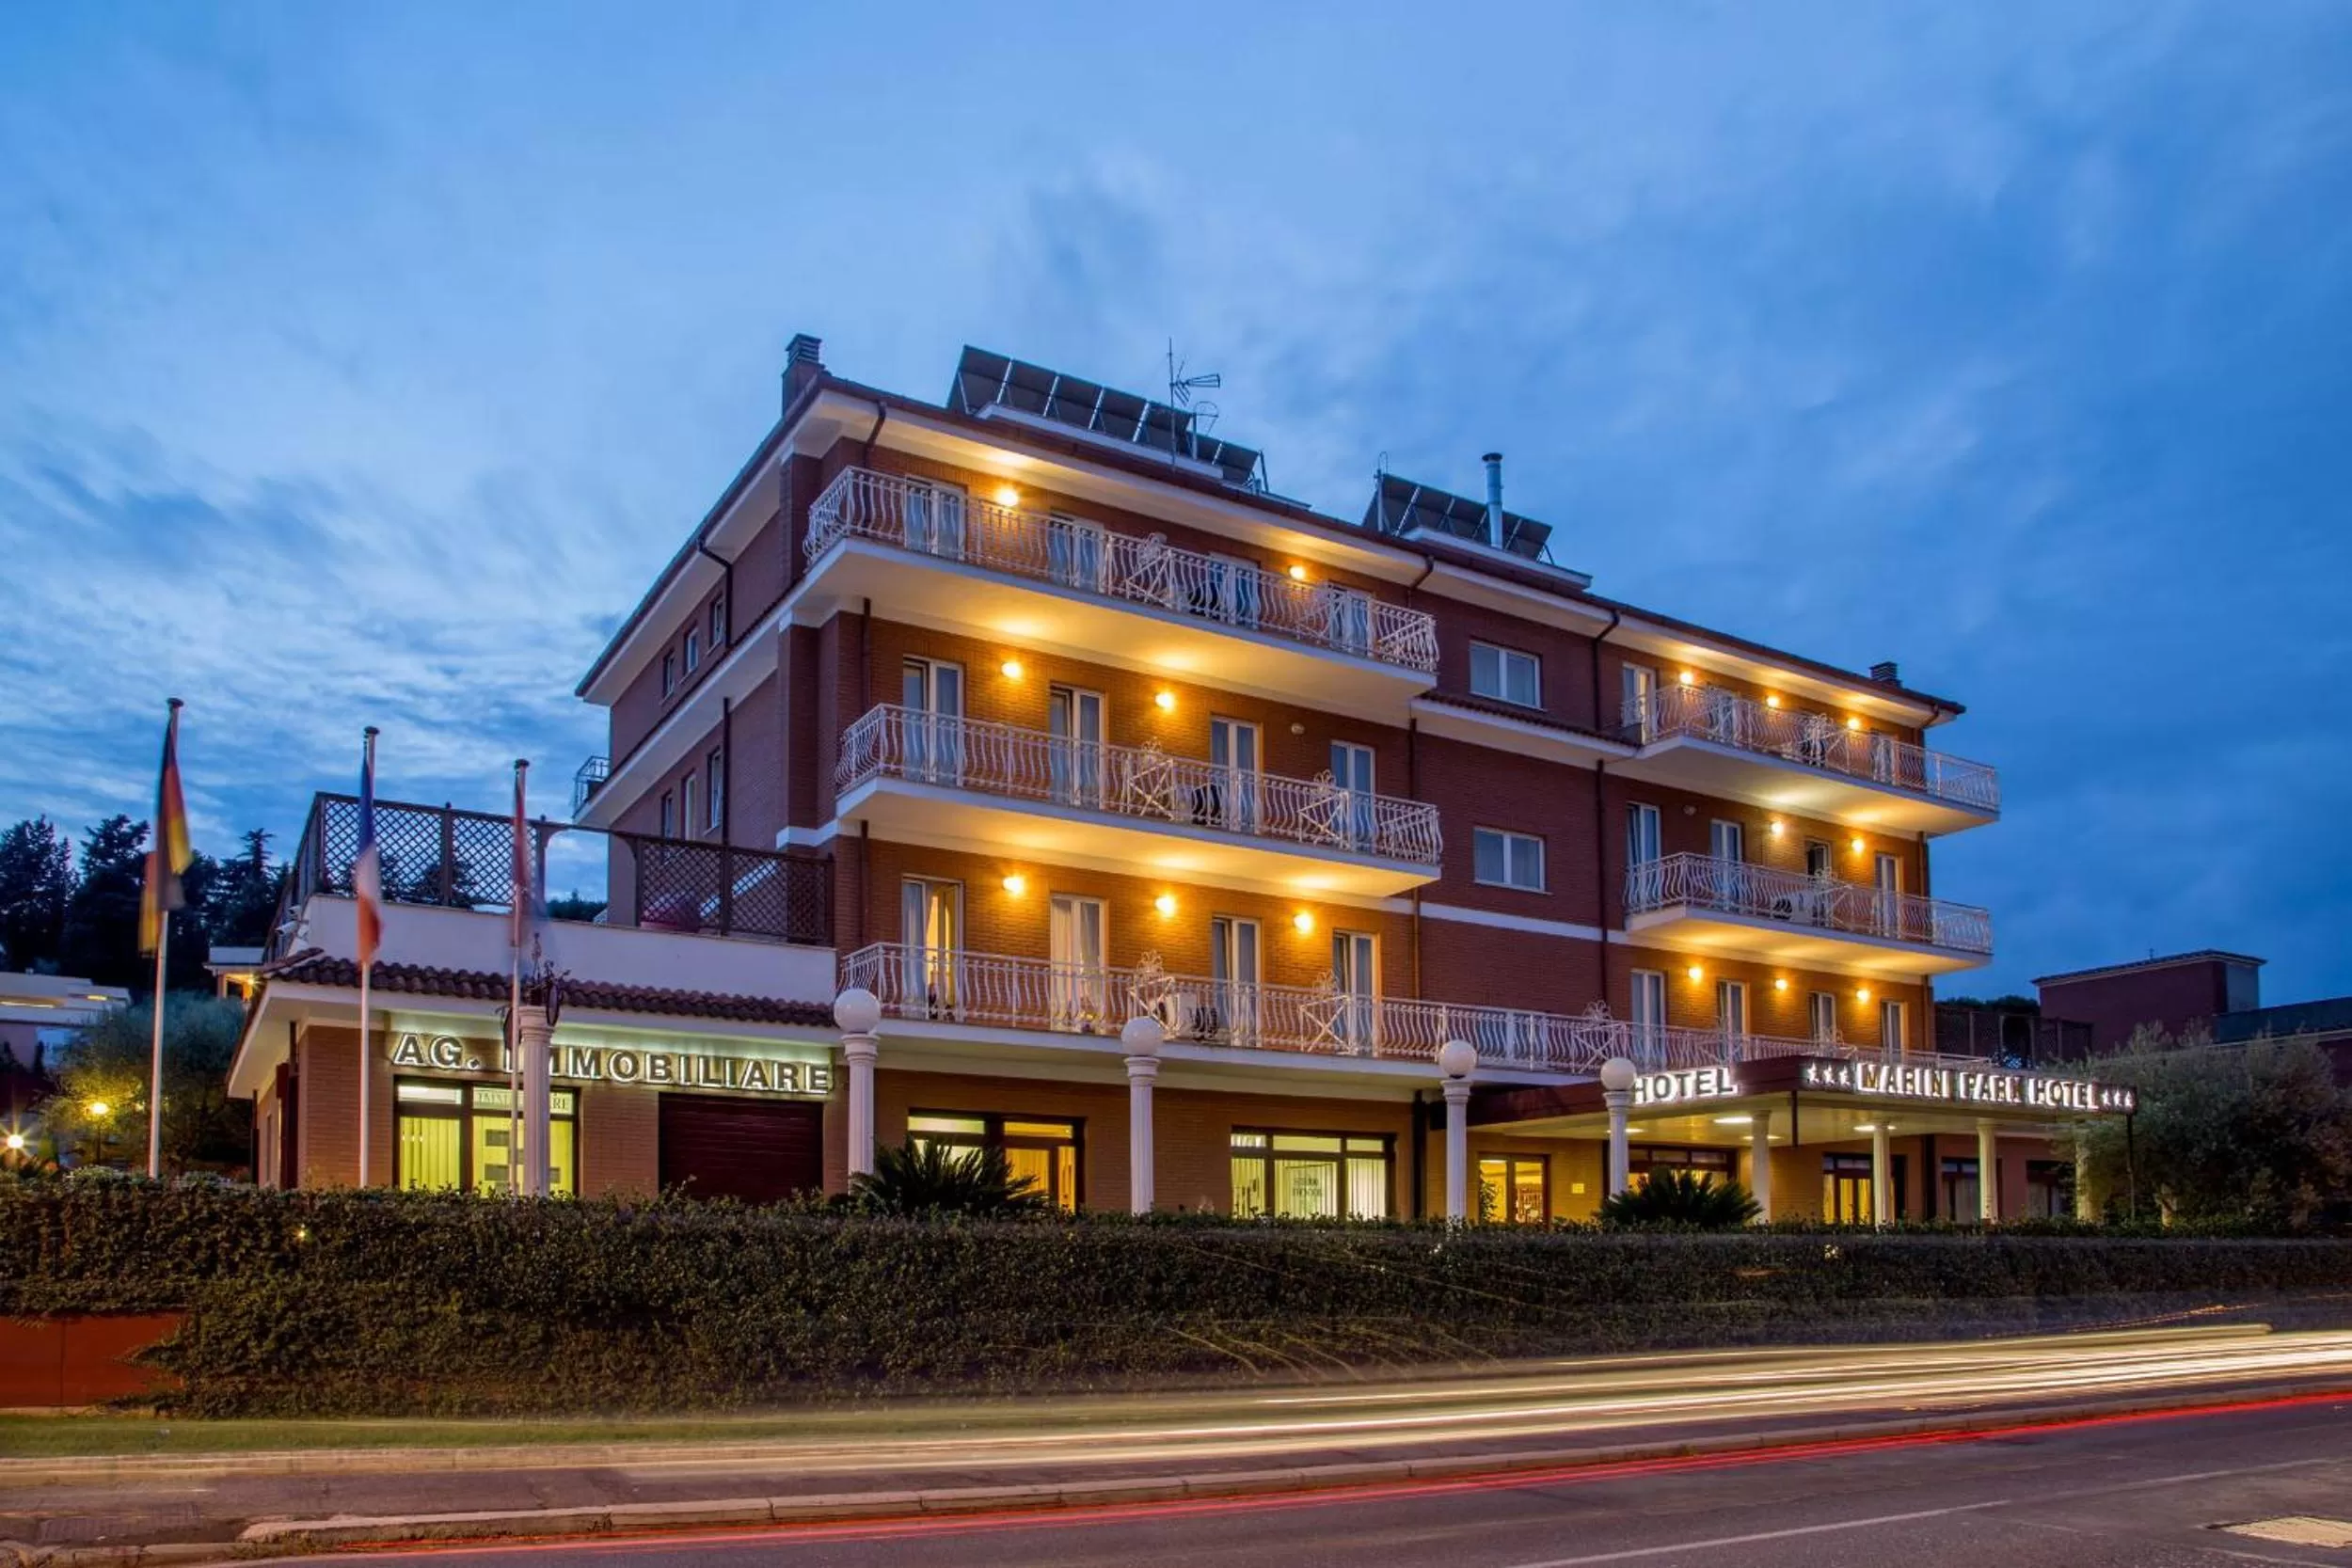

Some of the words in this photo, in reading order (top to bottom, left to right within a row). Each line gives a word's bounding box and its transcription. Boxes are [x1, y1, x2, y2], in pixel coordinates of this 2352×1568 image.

[393, 1033, 481, 1070] AG.
[1633, 1066, 1738, 1104] HOTEL
[1856, 1062, 1951, 1099] MARIN
[1959, 1071, 2022, 1103] PARK
[2027, 1078, 2100, 1110] HOTEL
